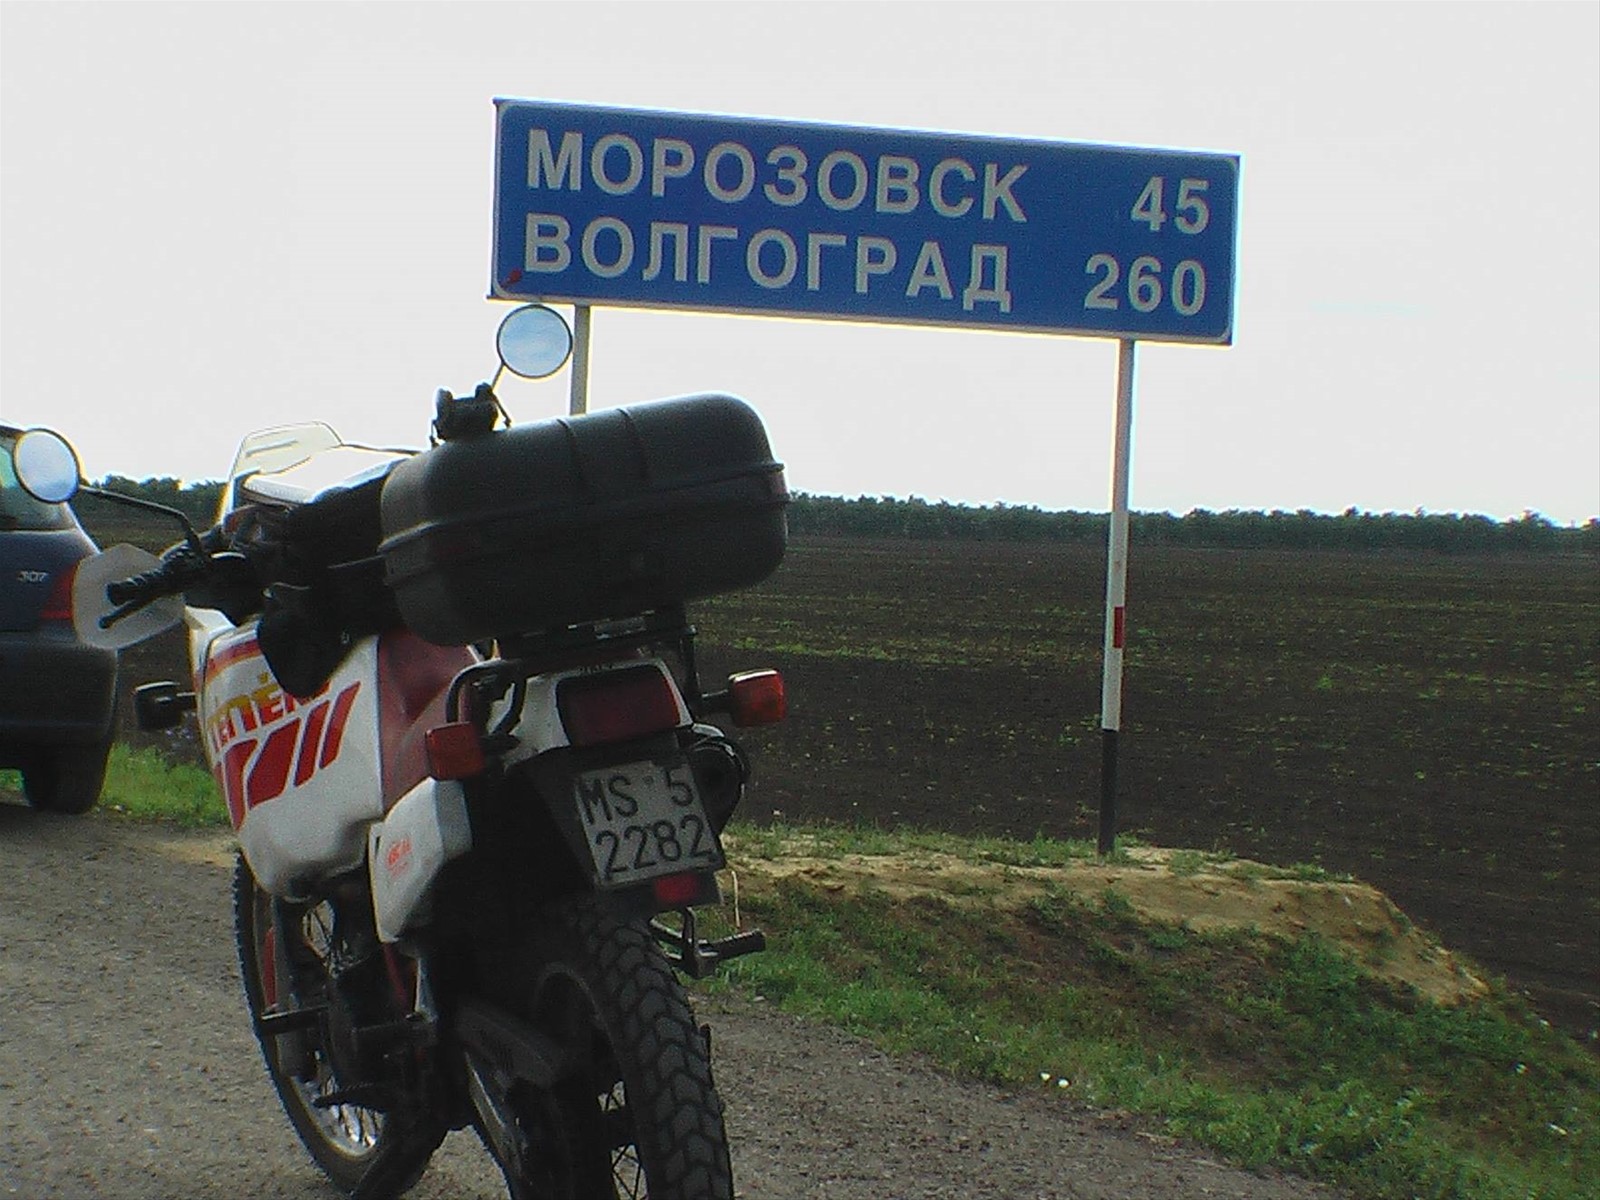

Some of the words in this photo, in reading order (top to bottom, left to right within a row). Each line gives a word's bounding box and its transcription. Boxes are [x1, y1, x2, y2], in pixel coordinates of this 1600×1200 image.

[527, 129, 1028, 222] МОРОЗОВСК
[1132, 176, 1210, 234] 45
[525, 213, 1012, 313] ВОЛГОГРАД
[1084, 254, 1206, 315] 260
[17, 571, 49, 582] 307
[579, 775, 639, 825] MS
[665, 764, 693, 807] 5
[596, 814, 714, 880] 2282
